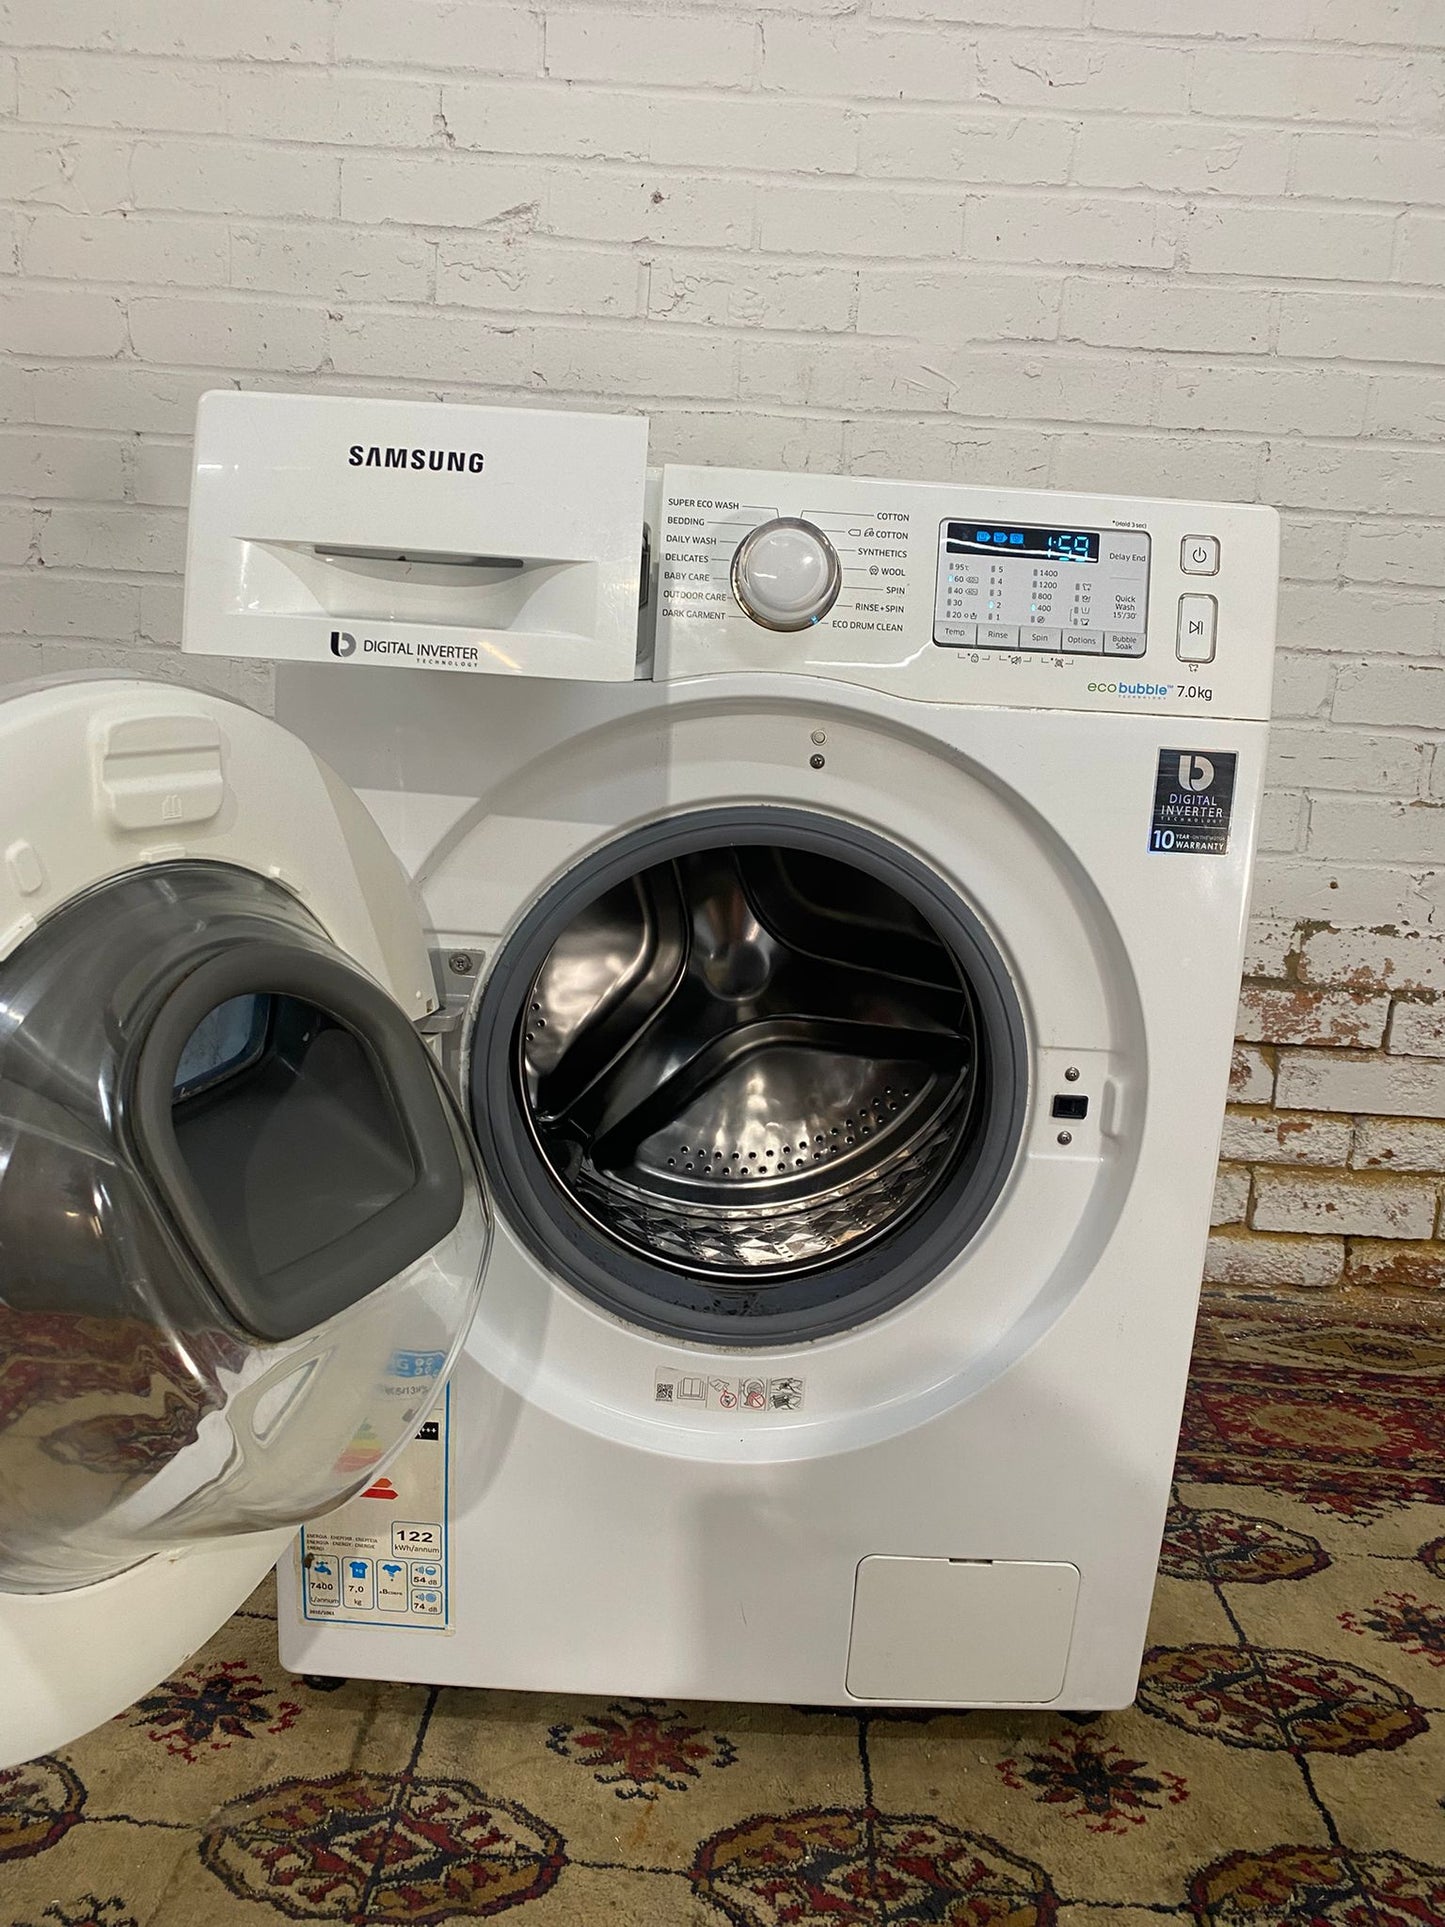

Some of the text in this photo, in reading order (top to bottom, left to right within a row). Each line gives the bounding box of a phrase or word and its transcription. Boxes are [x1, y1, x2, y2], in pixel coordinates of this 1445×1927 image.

[349, 445, 484, 473] SAMSUNG
[668, 498, 739, 509] SUPER ECO WASH
[667, 516, 705, 526] BEDDING
[877, 512, 909, 521] COTTON
[666, 535, 717, 545] DAILY WASH
[876, 530, 908, 540] COTTON
[858, 547, 907, 558] SYNTHETICS
[1109, 552, 1146, 562] Delay End
[665, 553, 709, 563] DELICATES
[664, 571, 710, 582] BABY CARE
[881, 567, 906, 576] WOOL
[1040, 569, 1058, 577] 1400
[954, 575, 964, 583] 60
[1039, 581, 1057, 589] 1200
[663, 590, 727, 601] OUTDOOR CARE
[886, 586, 905, 595] SPIN
[952, 599, 962, 607] 30
[1115, 594, 1136, 603] Quick
[1037, 604, 1051, 612] 400
[1115, 603, 1135, 611] Wash
[662, 609, 726, 619] DARK GARMENT
[952, 611, 961, 619] 20
[832, 620, 903, 632] ECO DRUM CLEAN
[945, 628, 965, 636] Temp
[988, 631, 1008, 639] Rinse
[1032, 633, 1048, 641] Spin
[1067, 635, 1096, 645] Options
[1113, 635, 1137, 643] Bubble
[364, 639, 478, 660] DIGITAL INVERTER
[416, 658, 479, 667] TECHNOLOGY
[1169, 793, 1217, 806] DIGITAL
[1161, 805, 1223, 818] INVERTER
[1153, 830, 1175, 849] 10
[1175, 841, 1225, 851] WARRANTY
[397, 1530, 433, 1542] 122
[394, 1544, 440, 1554] kWh/annum
[311, 1582, 333, 1590] 7400
